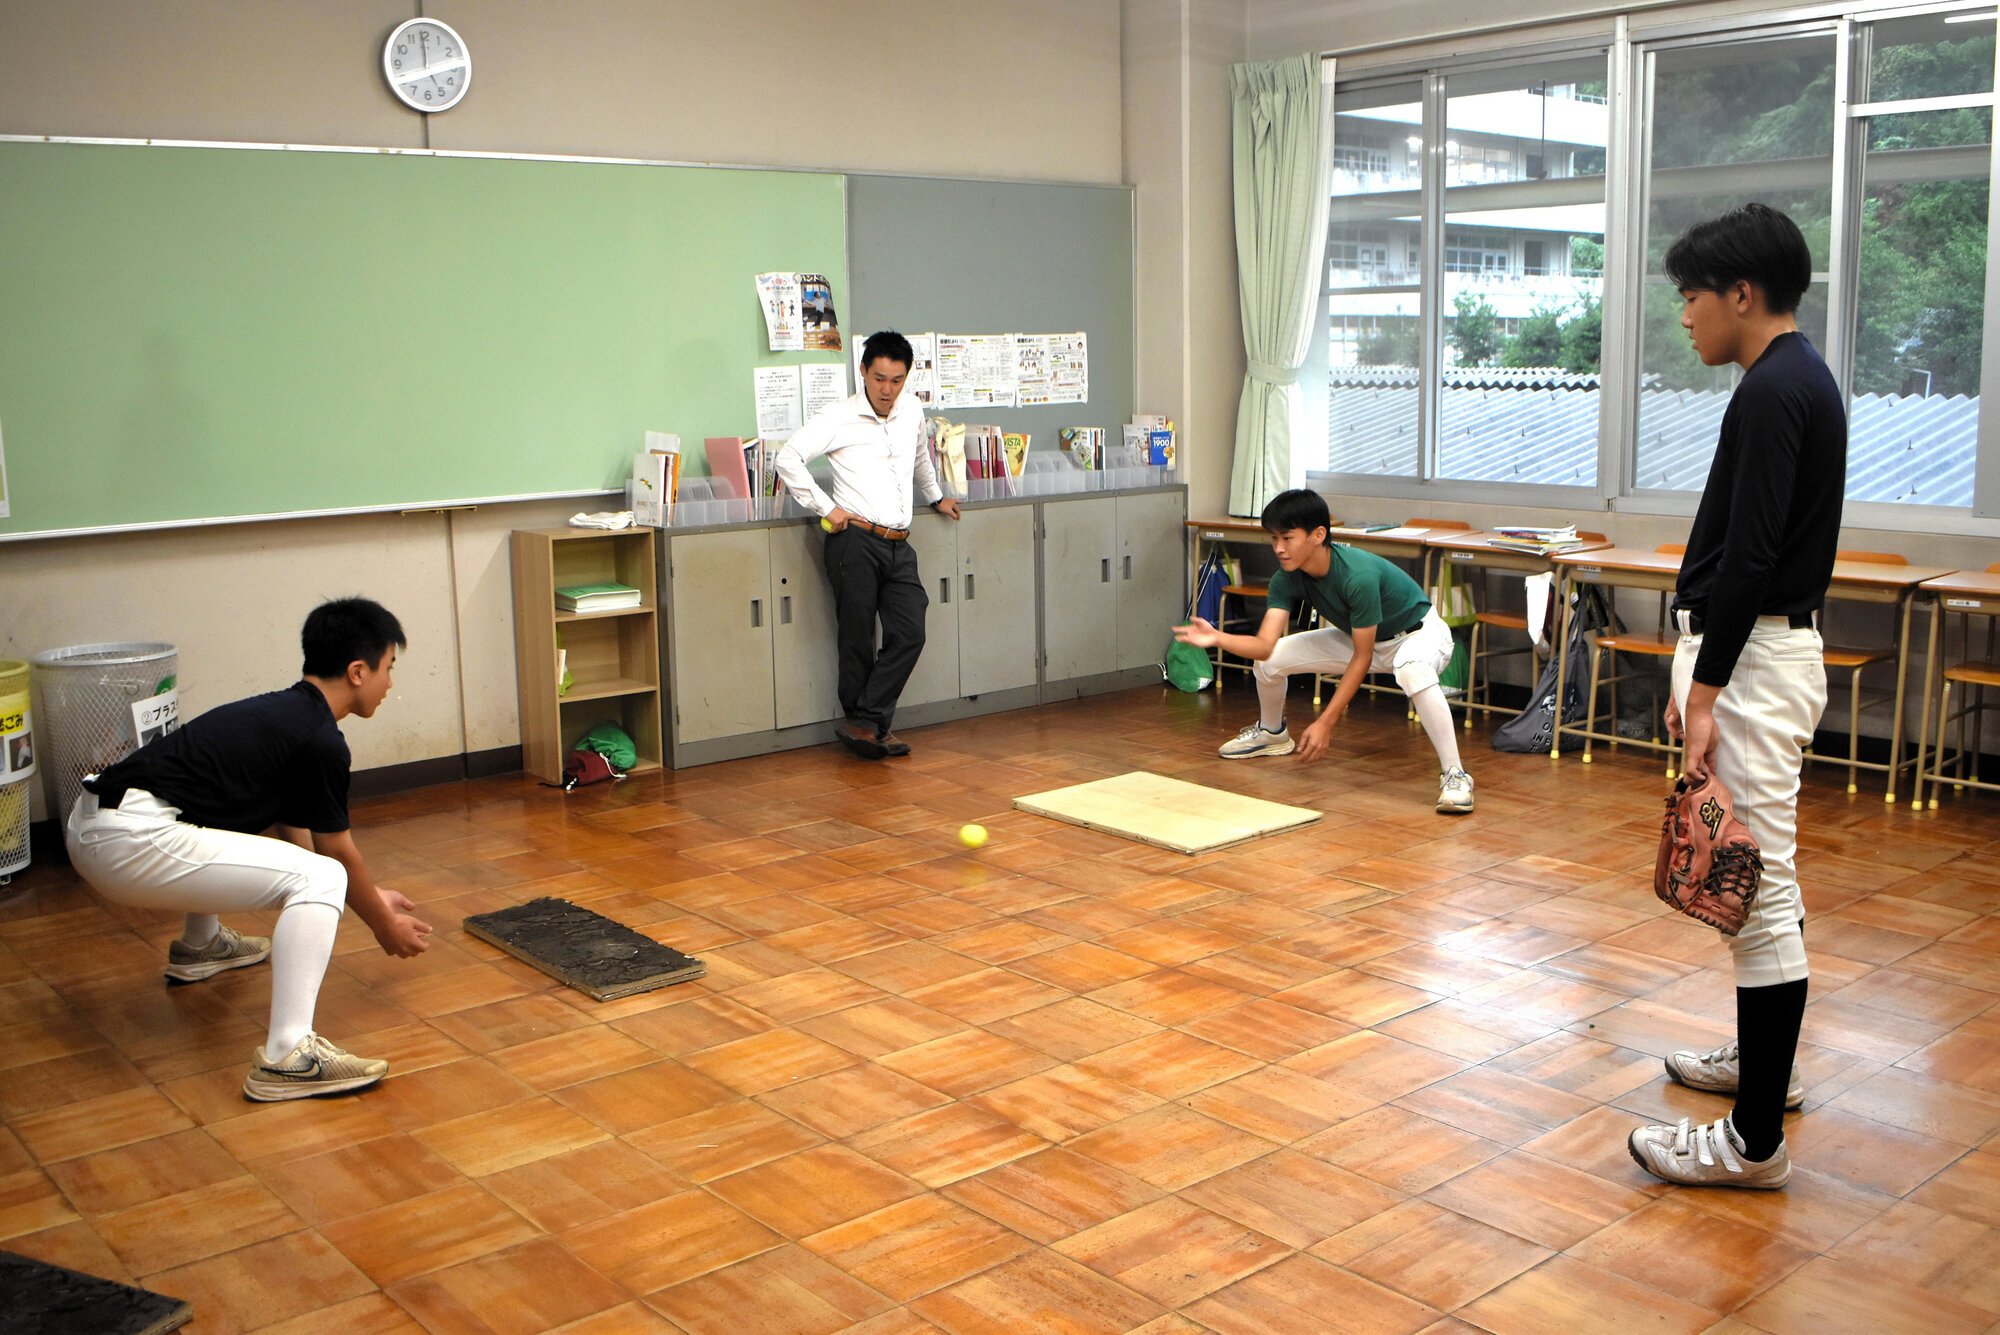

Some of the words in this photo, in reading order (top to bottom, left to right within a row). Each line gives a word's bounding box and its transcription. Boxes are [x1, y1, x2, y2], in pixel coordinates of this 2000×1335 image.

[407, 34, 415, 45] 11
[436, 36, 441, 46] 1
[397, 44, 408, 55] 10
[445, 47, 453, 57] 2
[394, 59, 402, 70] 9
[446, 77, 454, 87] 4
[410, 86, 418, 96] 7
[424, 90, 432, 101] 6
[438, 87, 446, 97] 5
[1003, 437, 1021, 447] VISTA
[1153, 439, 1170, 447] 1900
